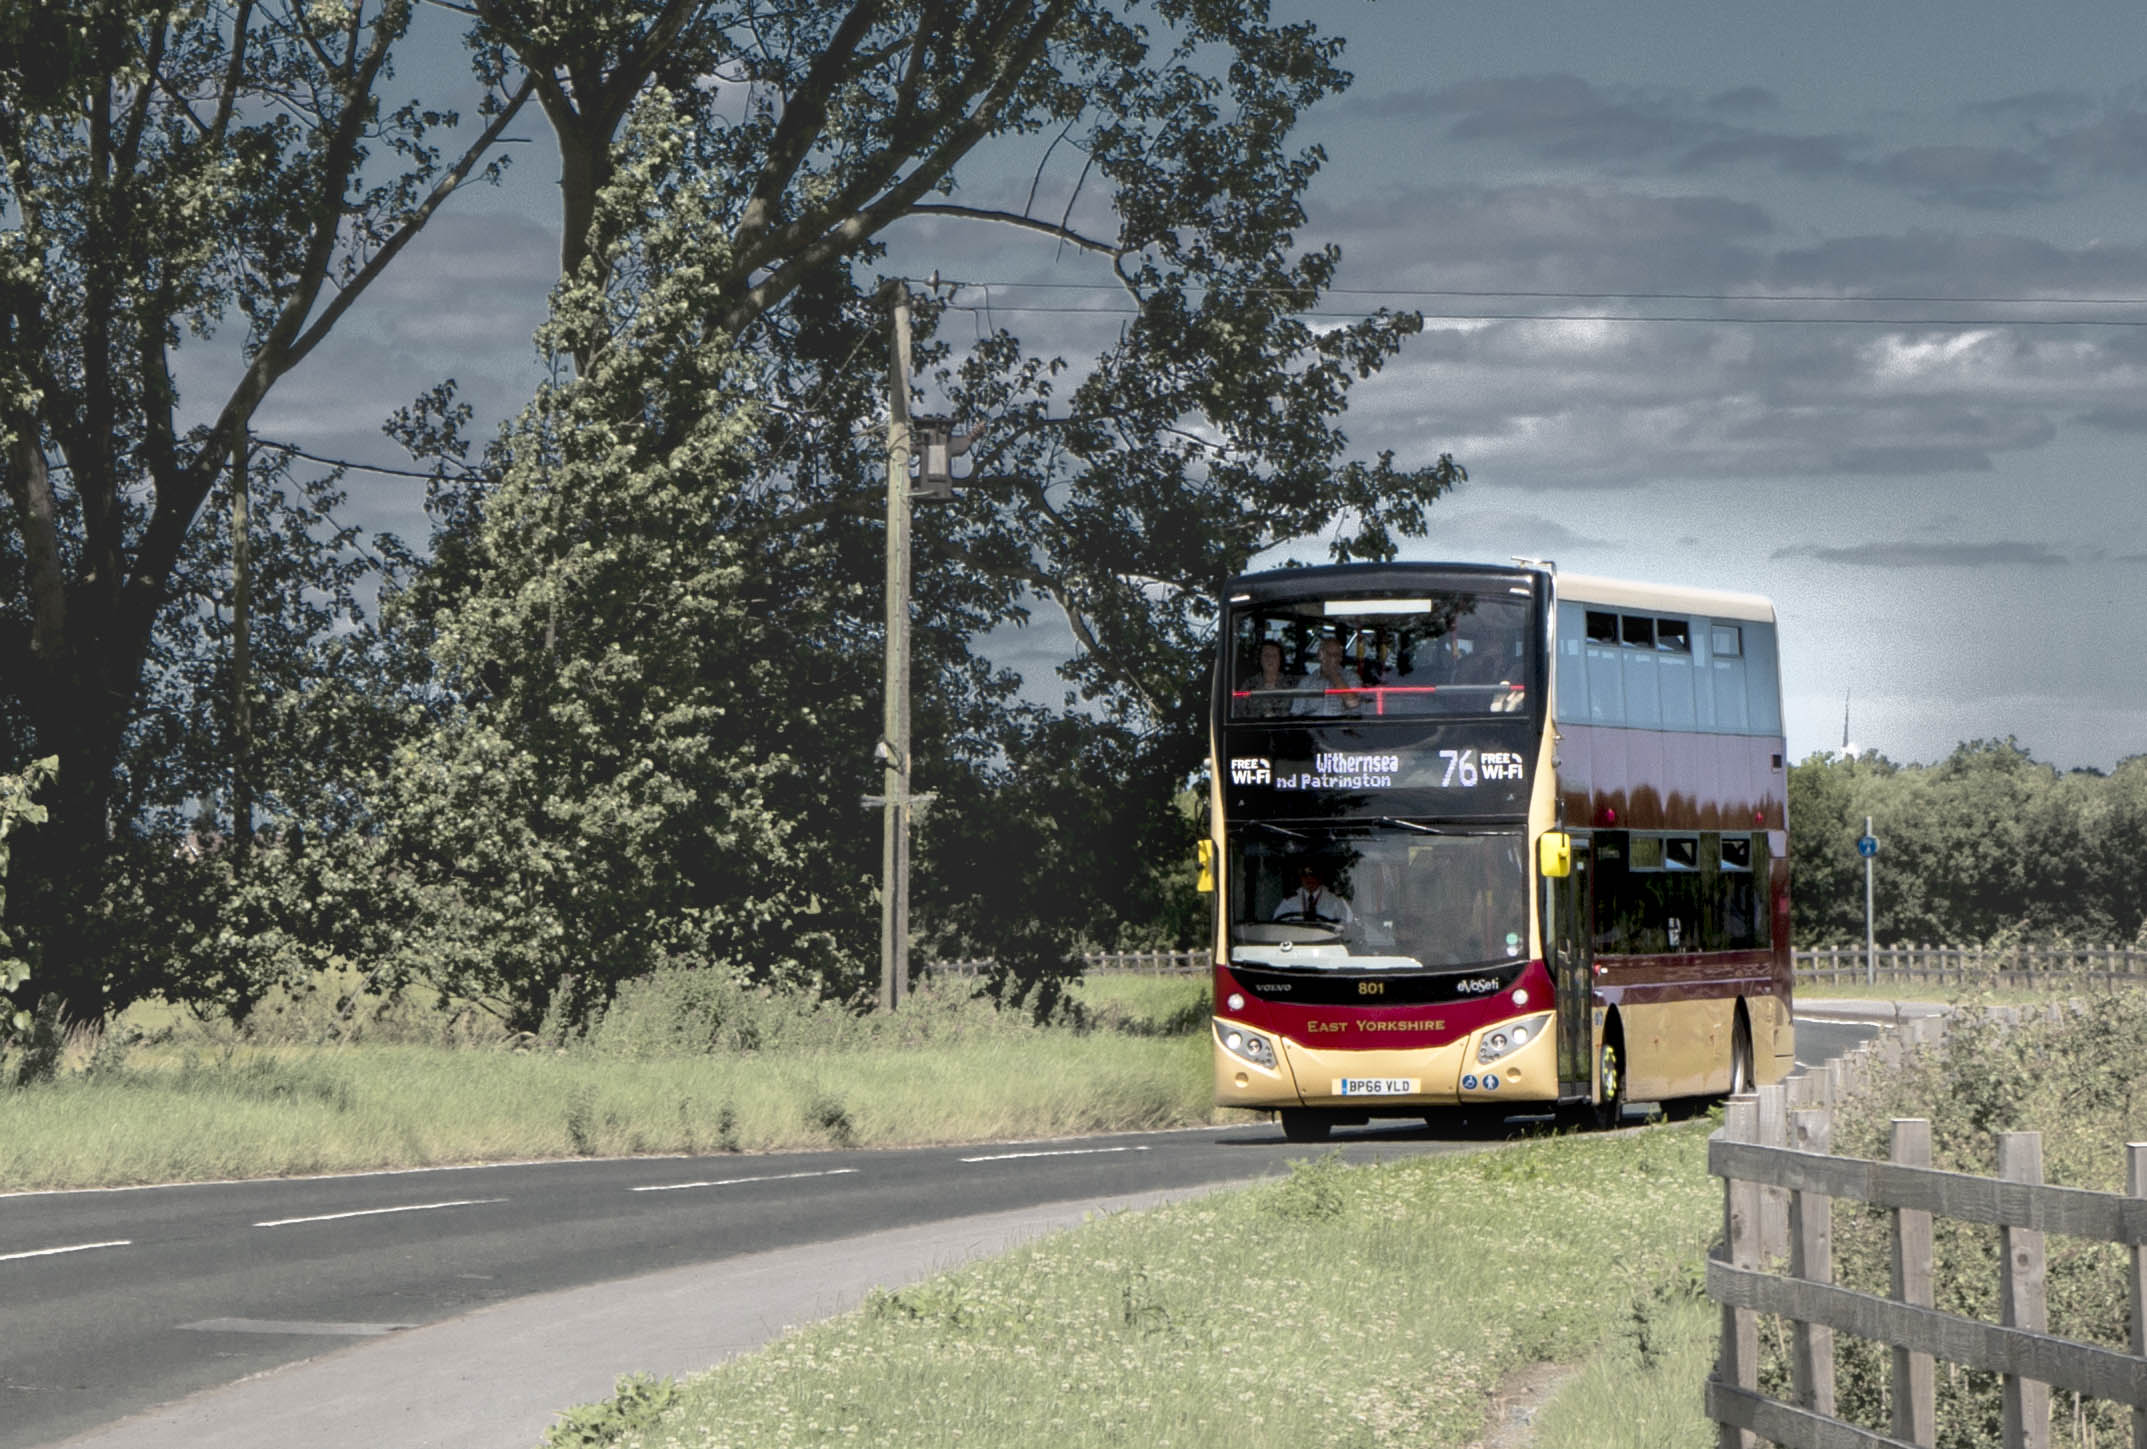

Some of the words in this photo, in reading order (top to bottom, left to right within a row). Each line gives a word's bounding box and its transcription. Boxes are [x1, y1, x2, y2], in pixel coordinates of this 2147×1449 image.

[1231, 758, 1258, 769] FREE
[1316, 753, 1399, 773] Withernsea
[1481, 753, 1510, 764] FREE
[1439, 750, 1478, 787] 76
[1301, 773, 1391, 789] Patrington
[1256, 984, 1292, 992] VOLVO
[1358, 983, 1385, 995] 801
[1307, 1020, 1349, 1033] EAST
[1356, 1020, 1446, 1032] YORKSHIRE
[1350, 1080, 1381, 1092] BP66
[1387, 1080, 1410, 1092] VLD
